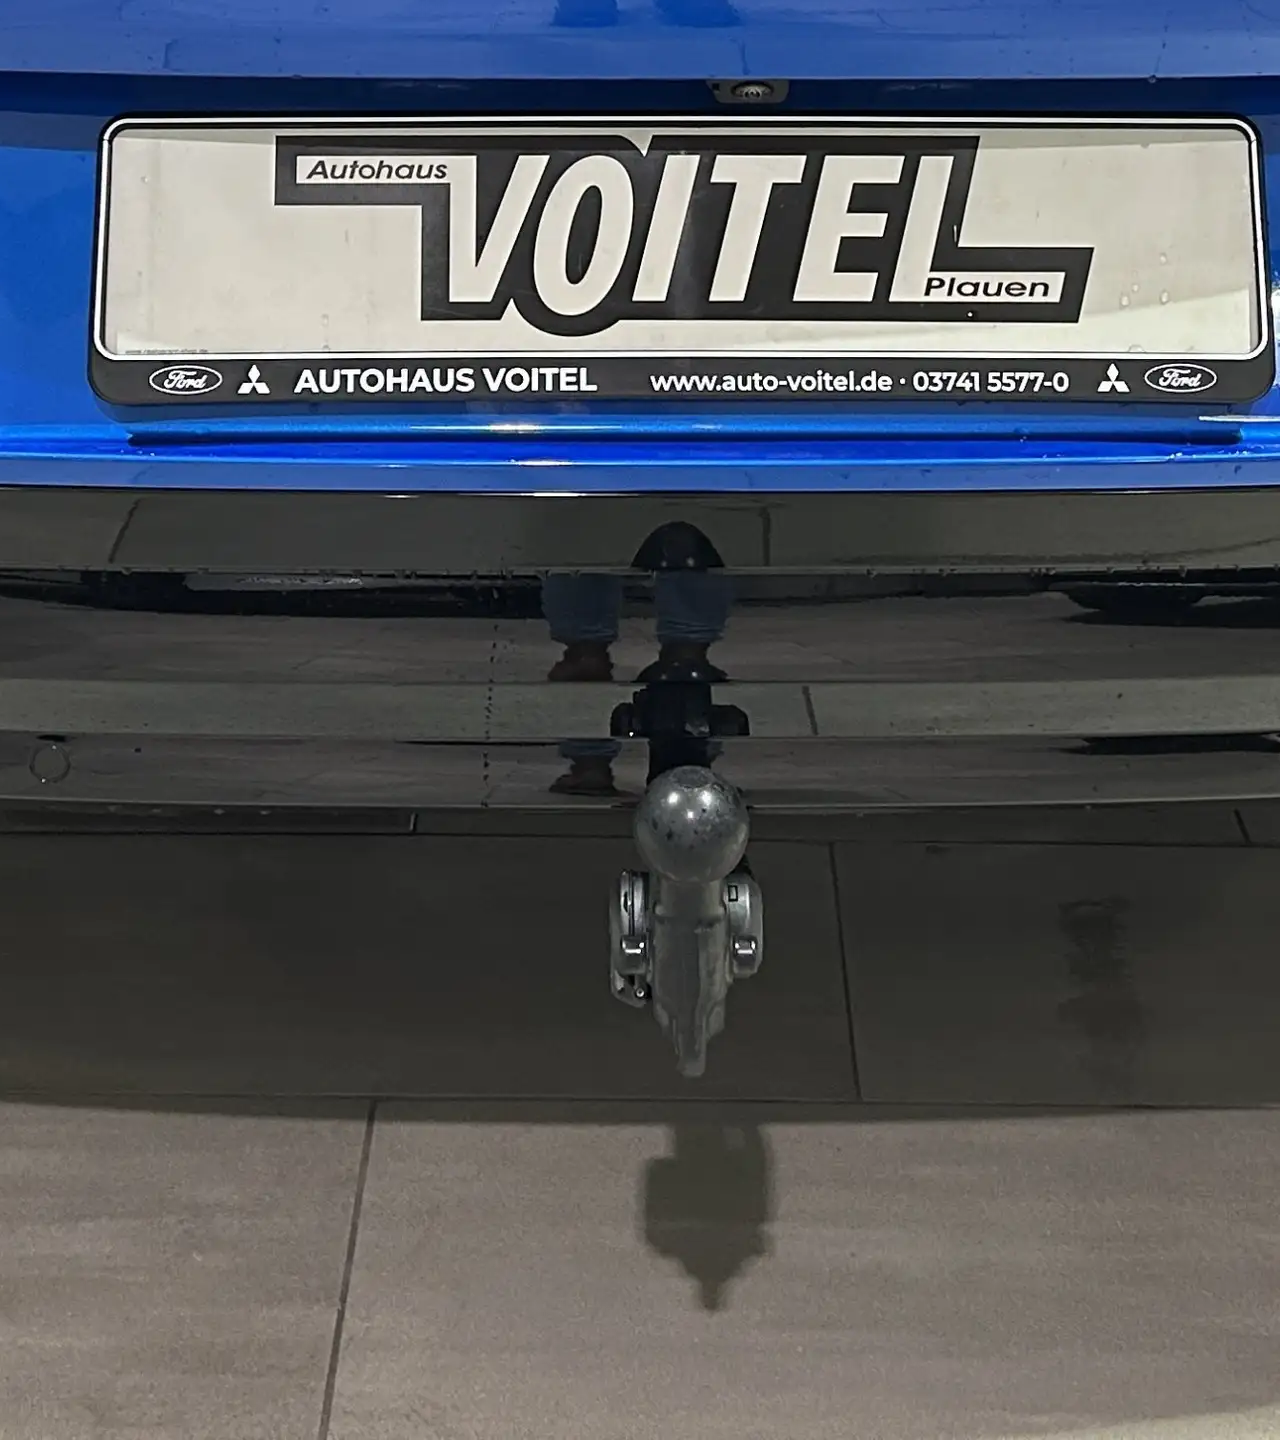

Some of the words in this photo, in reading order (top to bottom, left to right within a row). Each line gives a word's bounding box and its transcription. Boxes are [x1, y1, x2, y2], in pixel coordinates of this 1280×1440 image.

[305, 159, 449, 181] Autohaus
[447, 154, 1066, 317] VOITEL
[923, 276, 1051, 298] Plauen
[162, 365, 207, 392] Ford
[293, 367, 476, 394] AUTOHAUS
[480, 367, 598, 393] VOITEL
[650, 369, 892, 393] www.auto-voitel.de
[912, 369, 981, 393] 03741
[986, 369, 1070, 393] 5577-0
[1158, 367, 1203, 391] Ford
